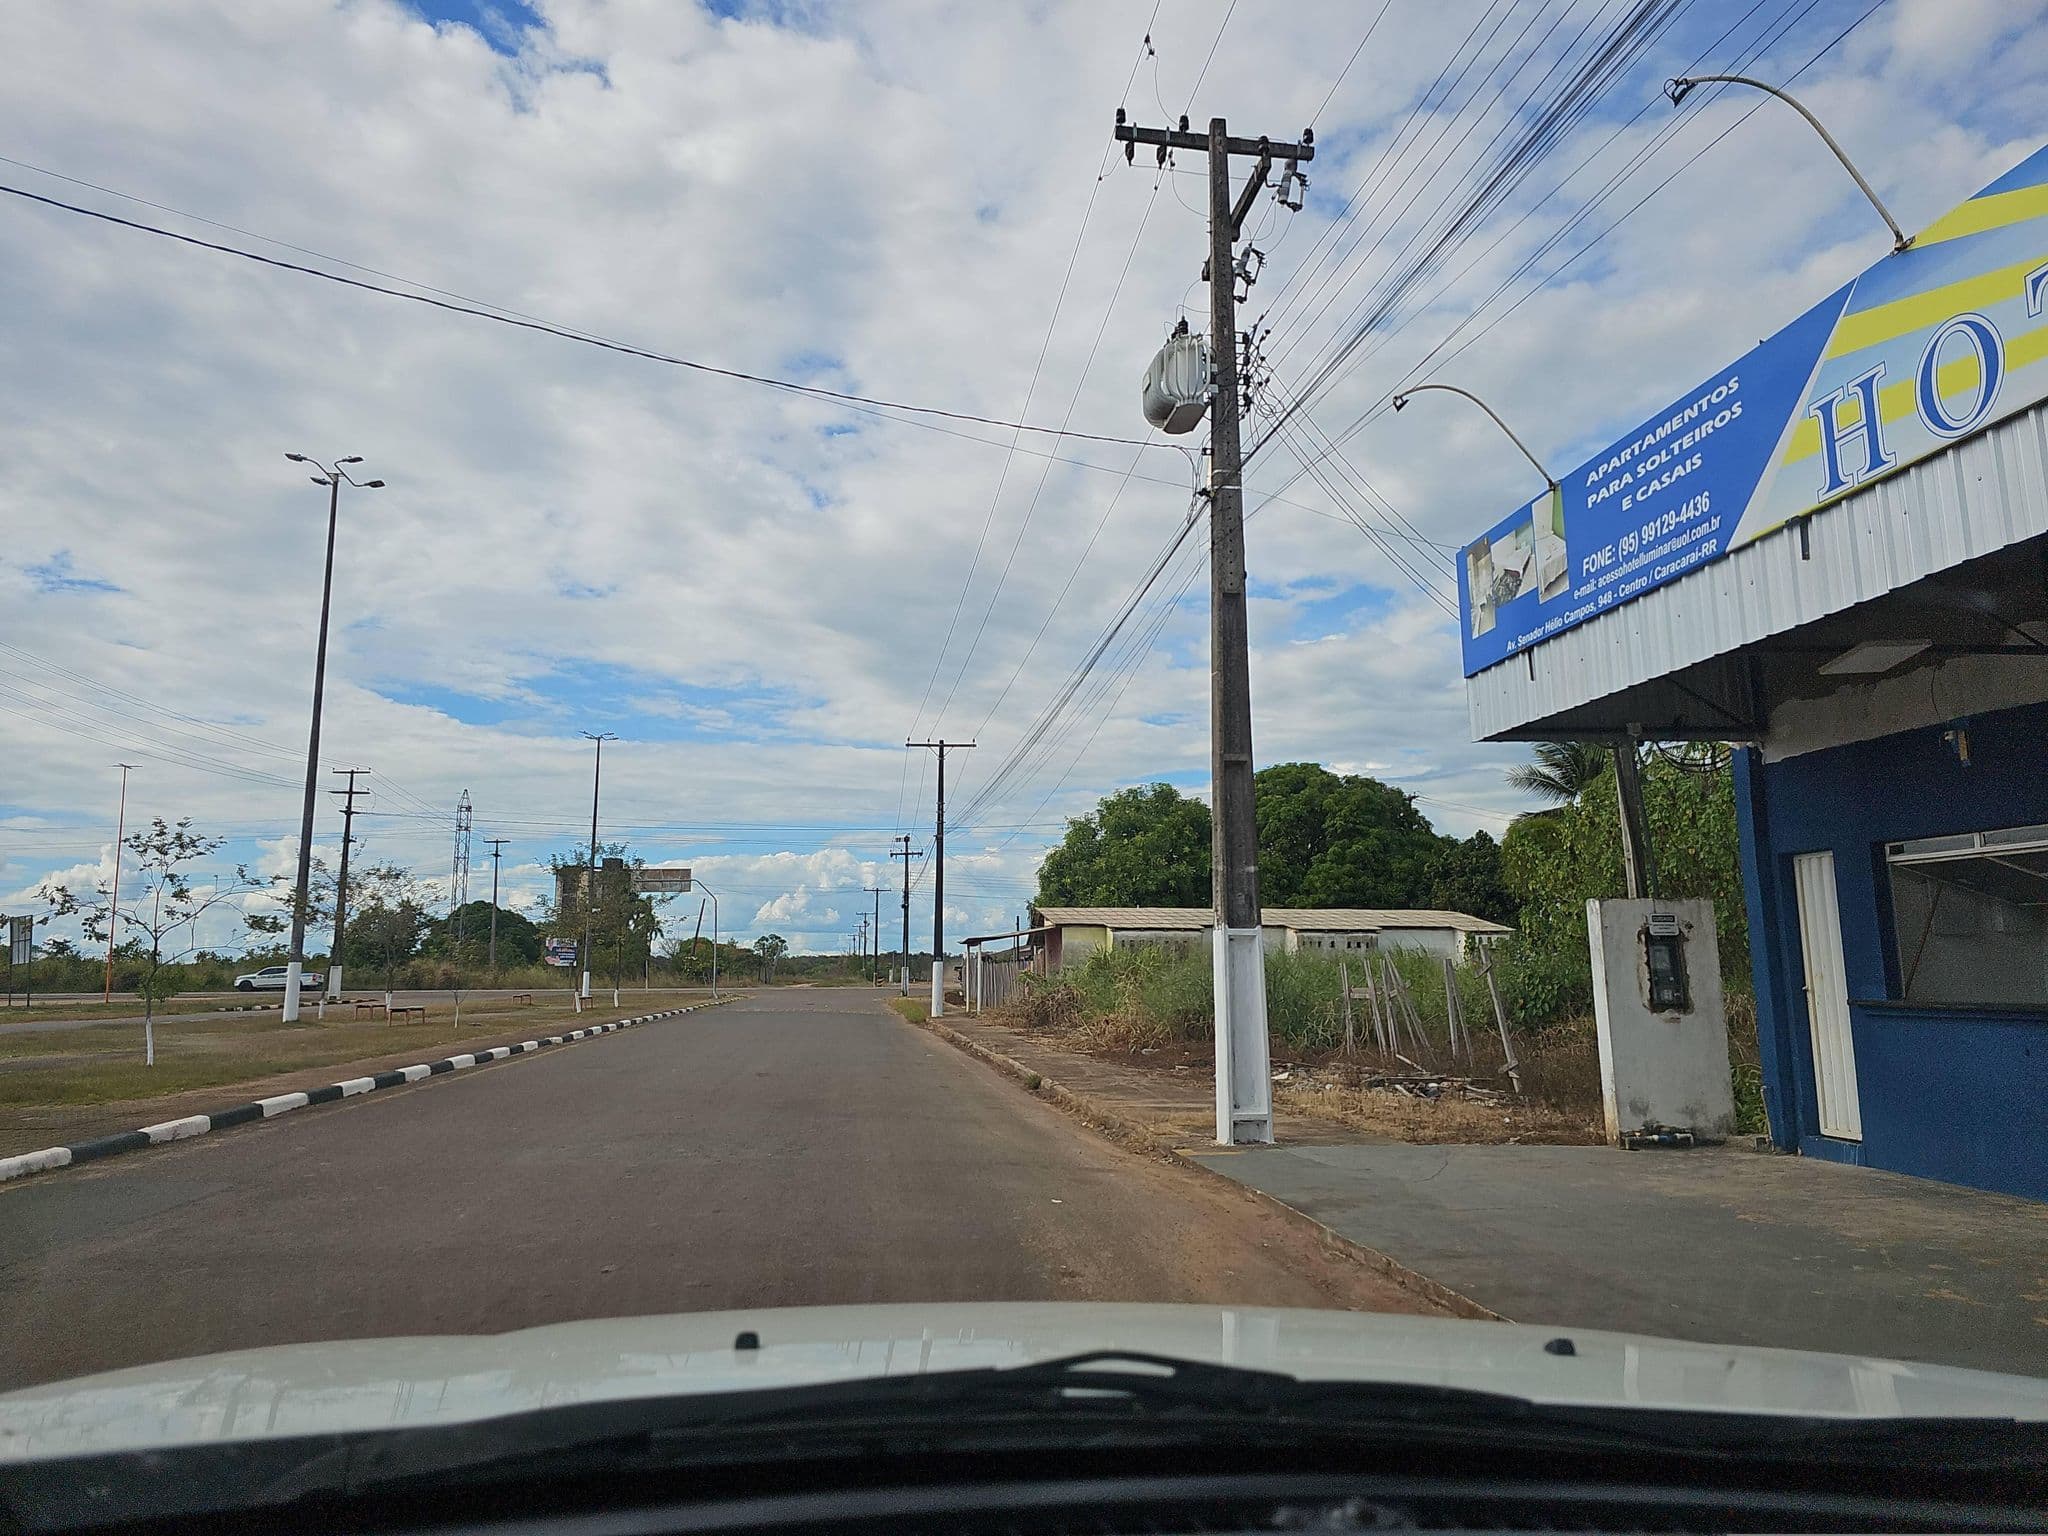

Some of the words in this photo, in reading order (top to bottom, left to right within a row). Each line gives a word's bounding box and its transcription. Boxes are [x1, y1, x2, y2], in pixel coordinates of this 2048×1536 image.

[1586, 376, 1739, 487] APARTAMENTOS
[1587, 472, 1634, 509] PARA
[1637, 401, 1742, 478] SOLTEIROS
[1622, 495, 1632, 511] E
[1636, 453, 1702, 501] CASAIS
[1583, 544, 1616, 577] FONE:
[1618, 530, 1638, 562] (95)
[1641, 491, 1710, 545] 99129-4436
[1506, 640, 1517, 652] Av.
[1517, 626, 1544, 646] Senador
[1564, 602, 1597, 620] Campos,
[1598, 591, 1613, 608] 948
[1619, 576, 1648, 597] Centro
[1573, 580, 1597, 600] e-mail:
